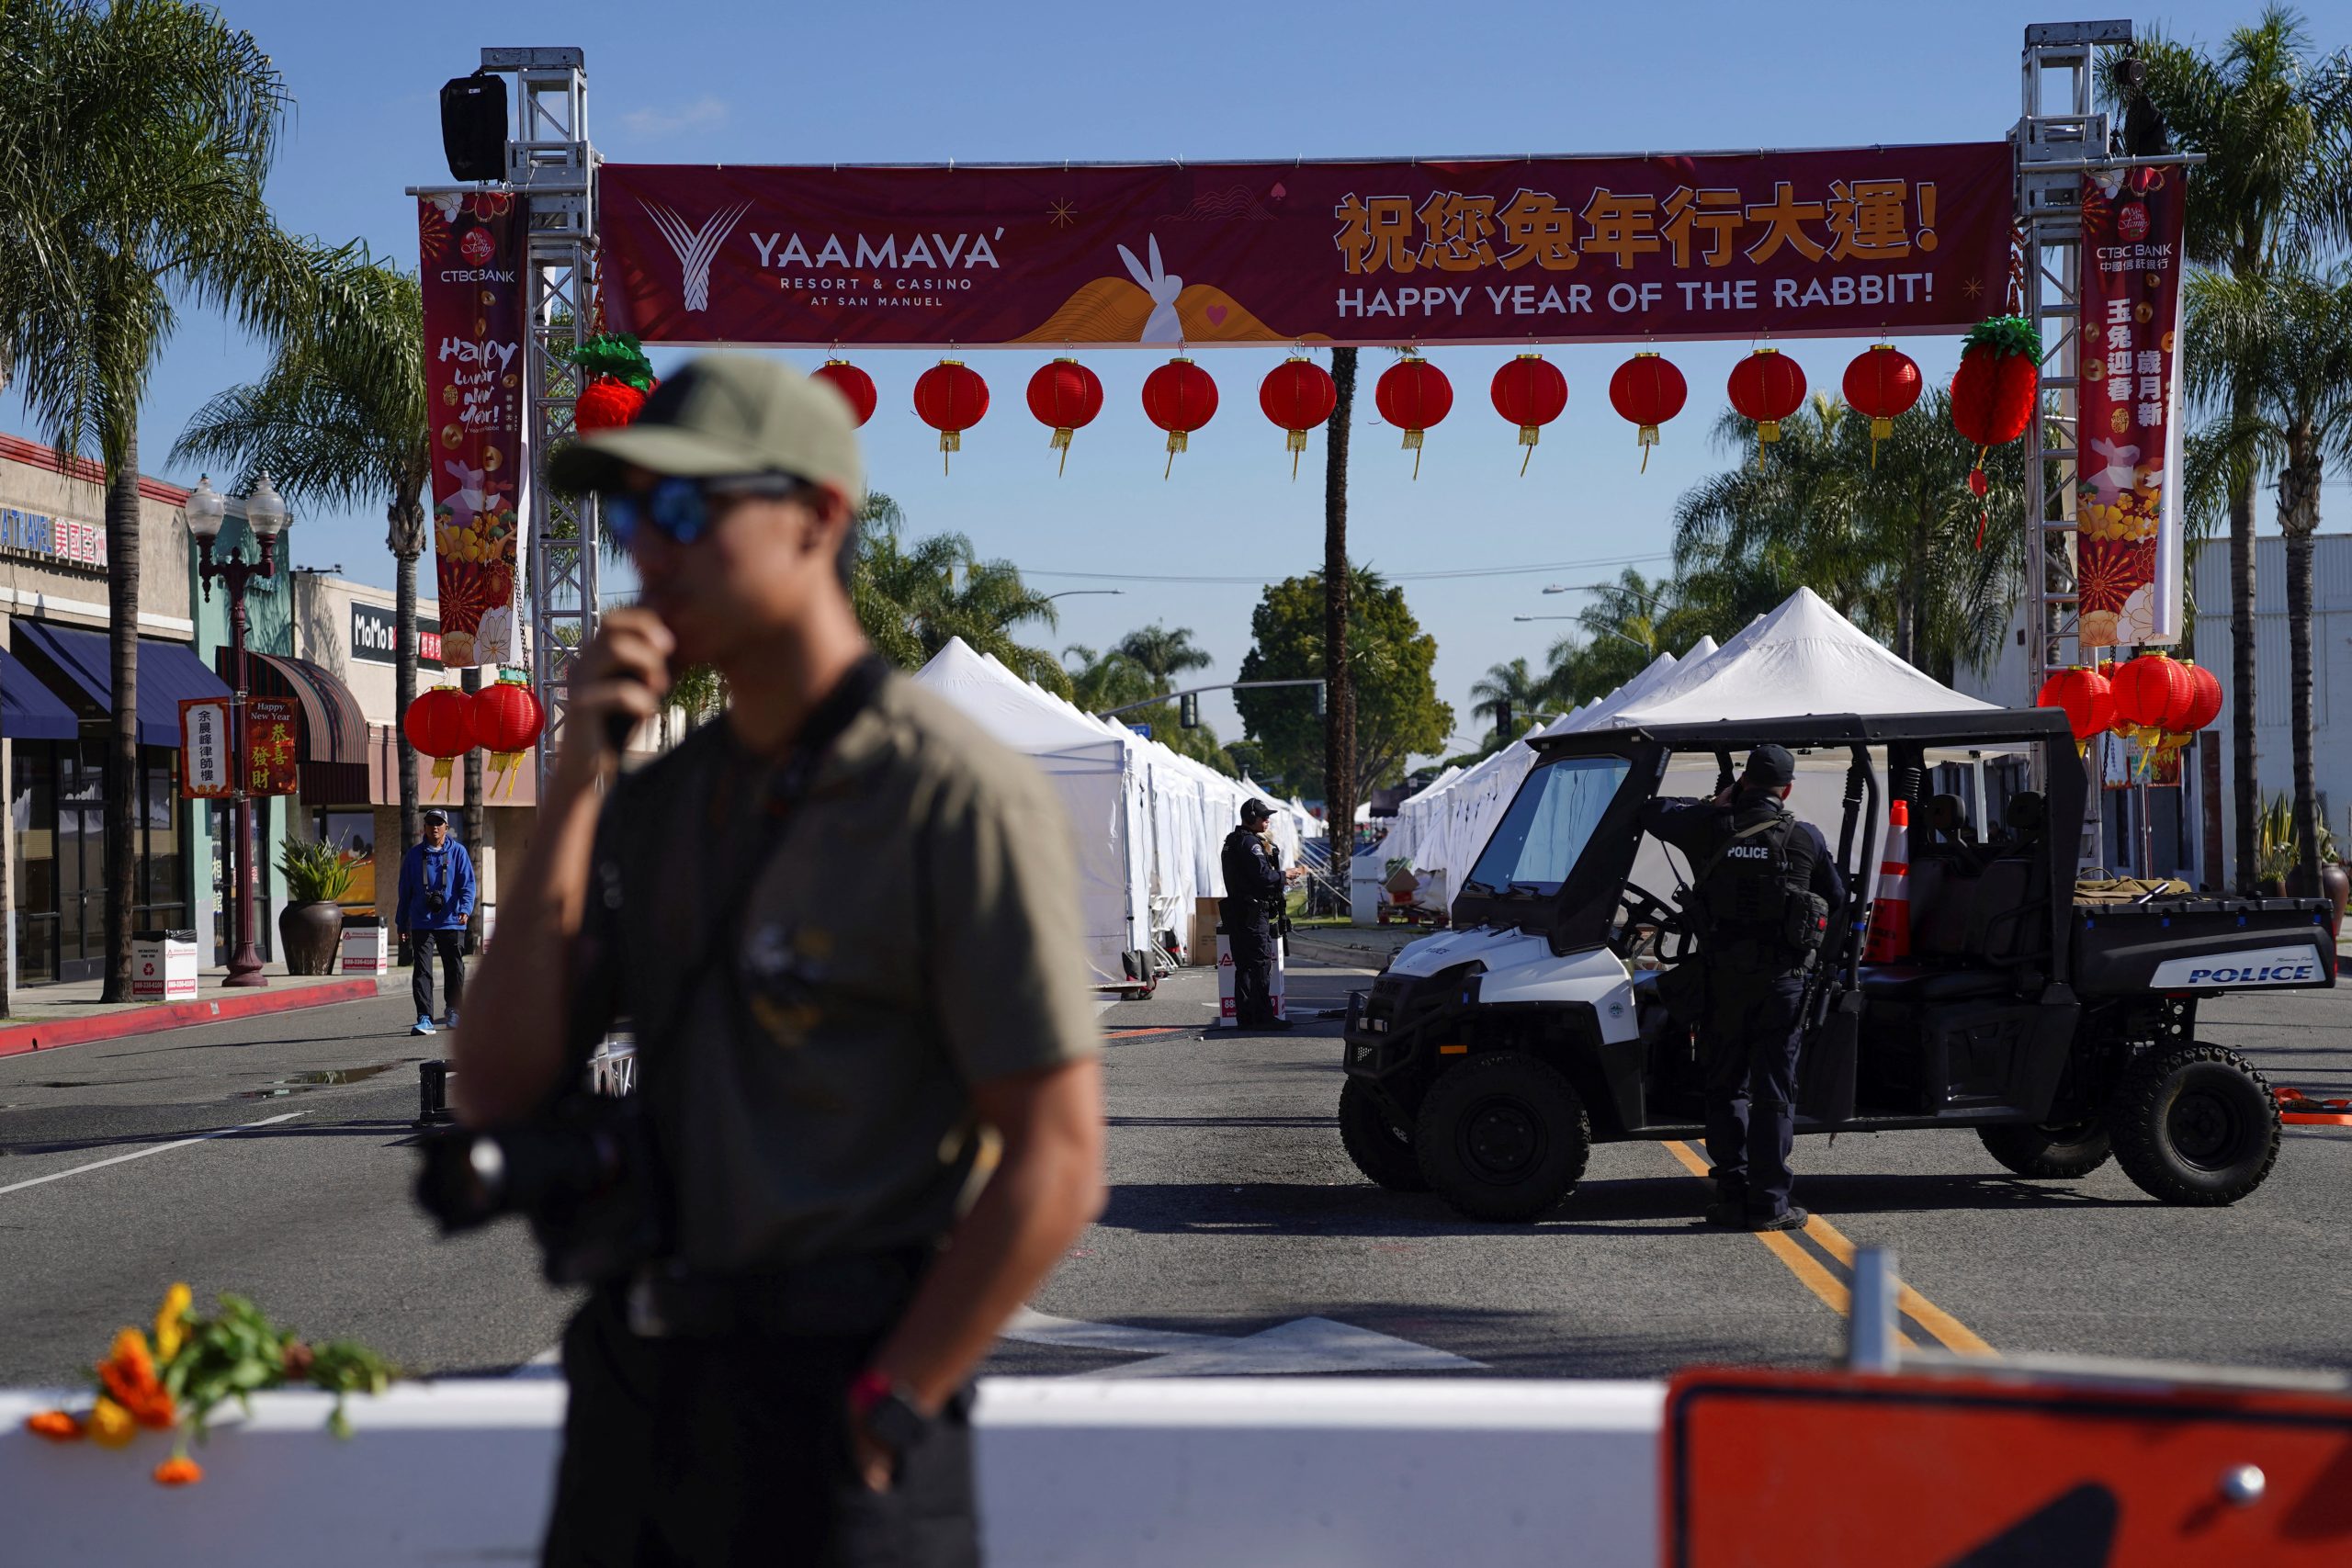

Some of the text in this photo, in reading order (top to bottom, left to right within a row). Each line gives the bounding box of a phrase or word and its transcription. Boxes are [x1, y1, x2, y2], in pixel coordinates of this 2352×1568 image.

[2097, 243, 2172, 259] CTBC BANK
[441, 270, 478, 282] CTBC
[781, 277, 972, 290] RESORT & CASINO
[810, 297, 943, 307] AT SAN MANUEL
[1336, 272, 1933, 317] HAPPY YEAR OF THE RABBIT!
[2107, 299, 2132, 401] 玉兔迎春
[2137, 350, 2162, 427] 歲月新
[10, 509, 52, 553] TRAVEL
[257, 703, 285, 712] Happy
[251, 712, 290, 721] New Year
[251, 747, 271, 789] 發財
[1727, 846, 1769, 859] POLICE
[2188, 965, 2314, 984] POLICE
